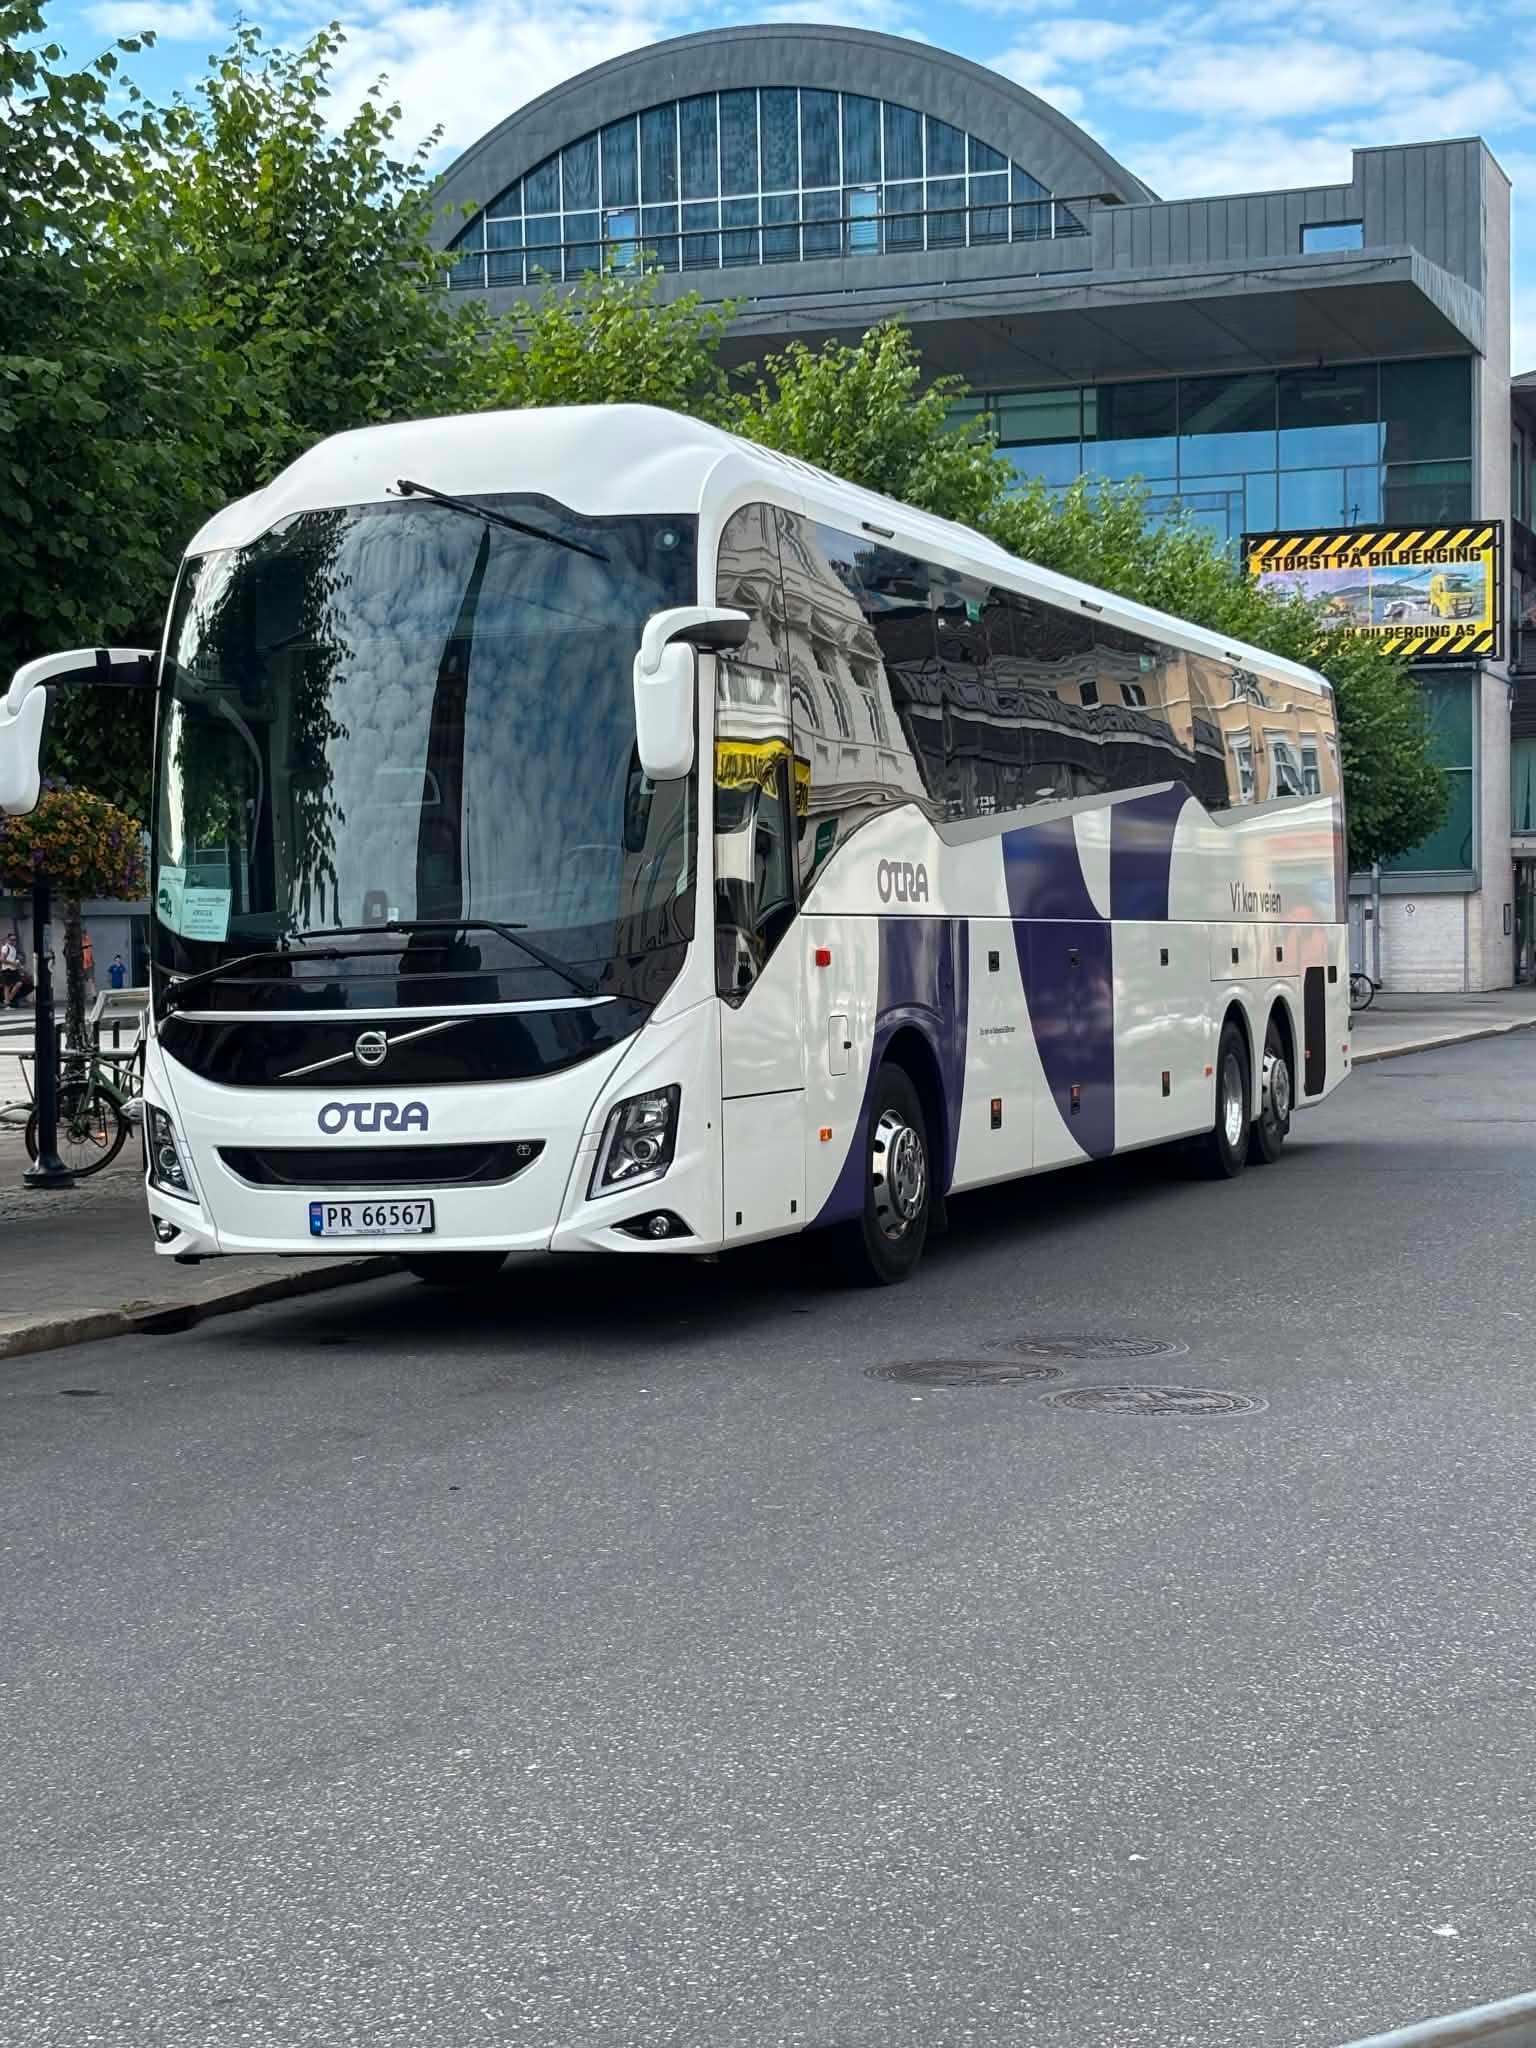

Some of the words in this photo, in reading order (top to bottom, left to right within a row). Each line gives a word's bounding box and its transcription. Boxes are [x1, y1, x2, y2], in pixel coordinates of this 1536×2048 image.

[1260, 554, 1332, 572] STØRST
[1337, 548, 1364, 569] PÅ
[1368, 546, 1482, 567] BILBERGING
[1455, 624, 1476, 637] AS
[877, 858, 929, 903] OTRA
[1230, 882, 1240, 912] Vi
[1242, 882, 1259, 912] kan
[1259, 883, 1281, 912] veien
[317, 1101, 429, 1135] OTRA
[327, 1206, 352, 1227] PR
[362, 1204, 425, 1226] 66567
